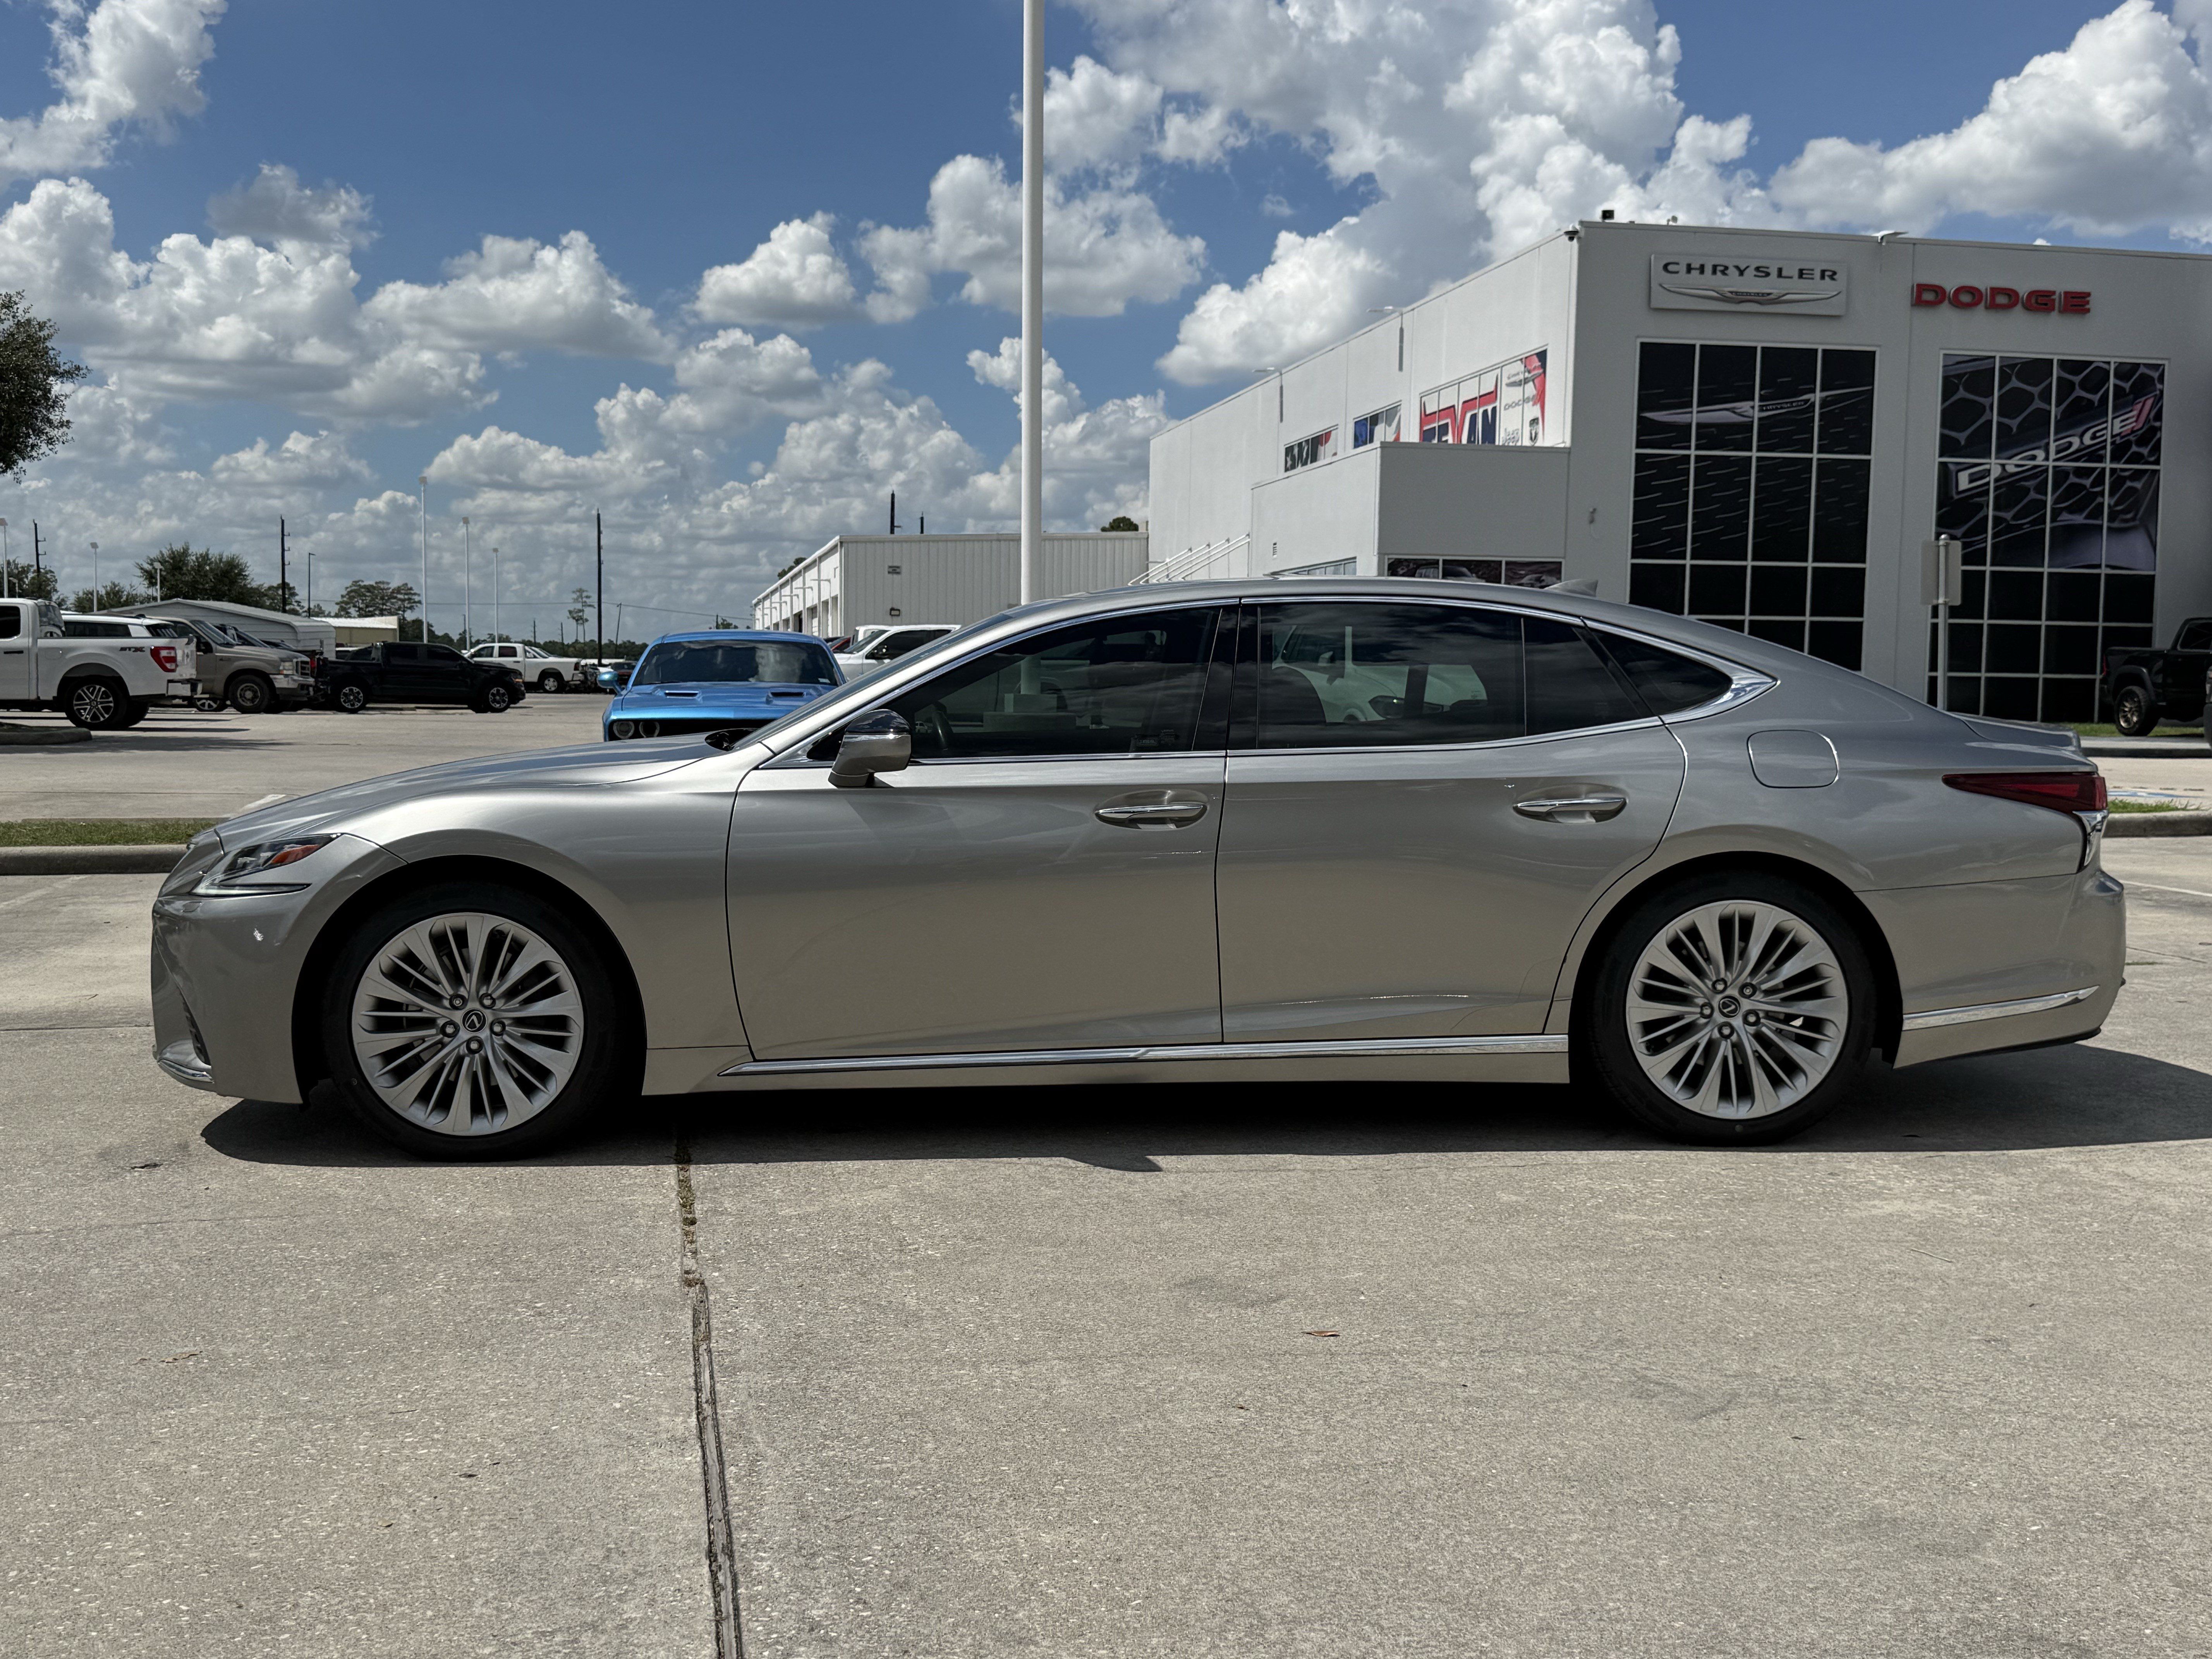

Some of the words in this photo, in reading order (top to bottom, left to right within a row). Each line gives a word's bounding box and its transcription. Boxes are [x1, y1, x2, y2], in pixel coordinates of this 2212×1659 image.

[1662, 261, 1838, 282] CHRYSLER
[1911, 283, 2091, 314] DODGE
[1957, 410, 2137, 491] DODGE
